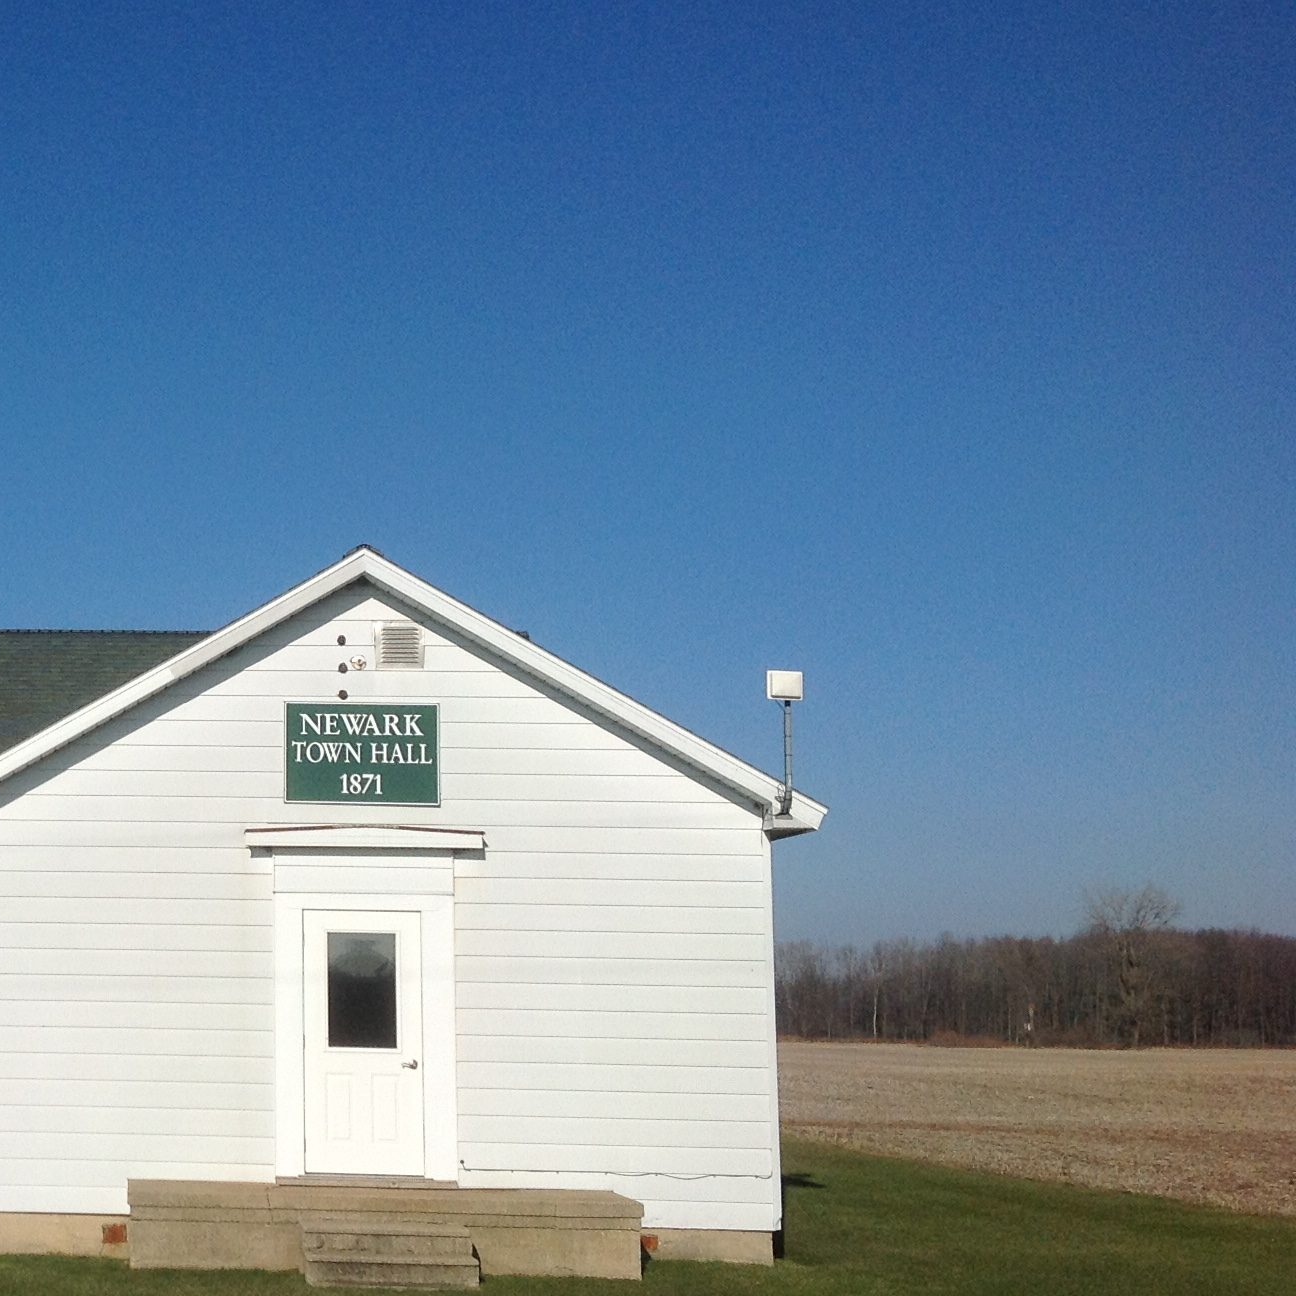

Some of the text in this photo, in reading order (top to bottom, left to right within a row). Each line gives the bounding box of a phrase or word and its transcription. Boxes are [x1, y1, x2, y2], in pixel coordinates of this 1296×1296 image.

[299, 713, 424, 736] NEWARK
[292, 741, 433, 764] TOWN HALL
[339, 773, 383, 795] 1871
